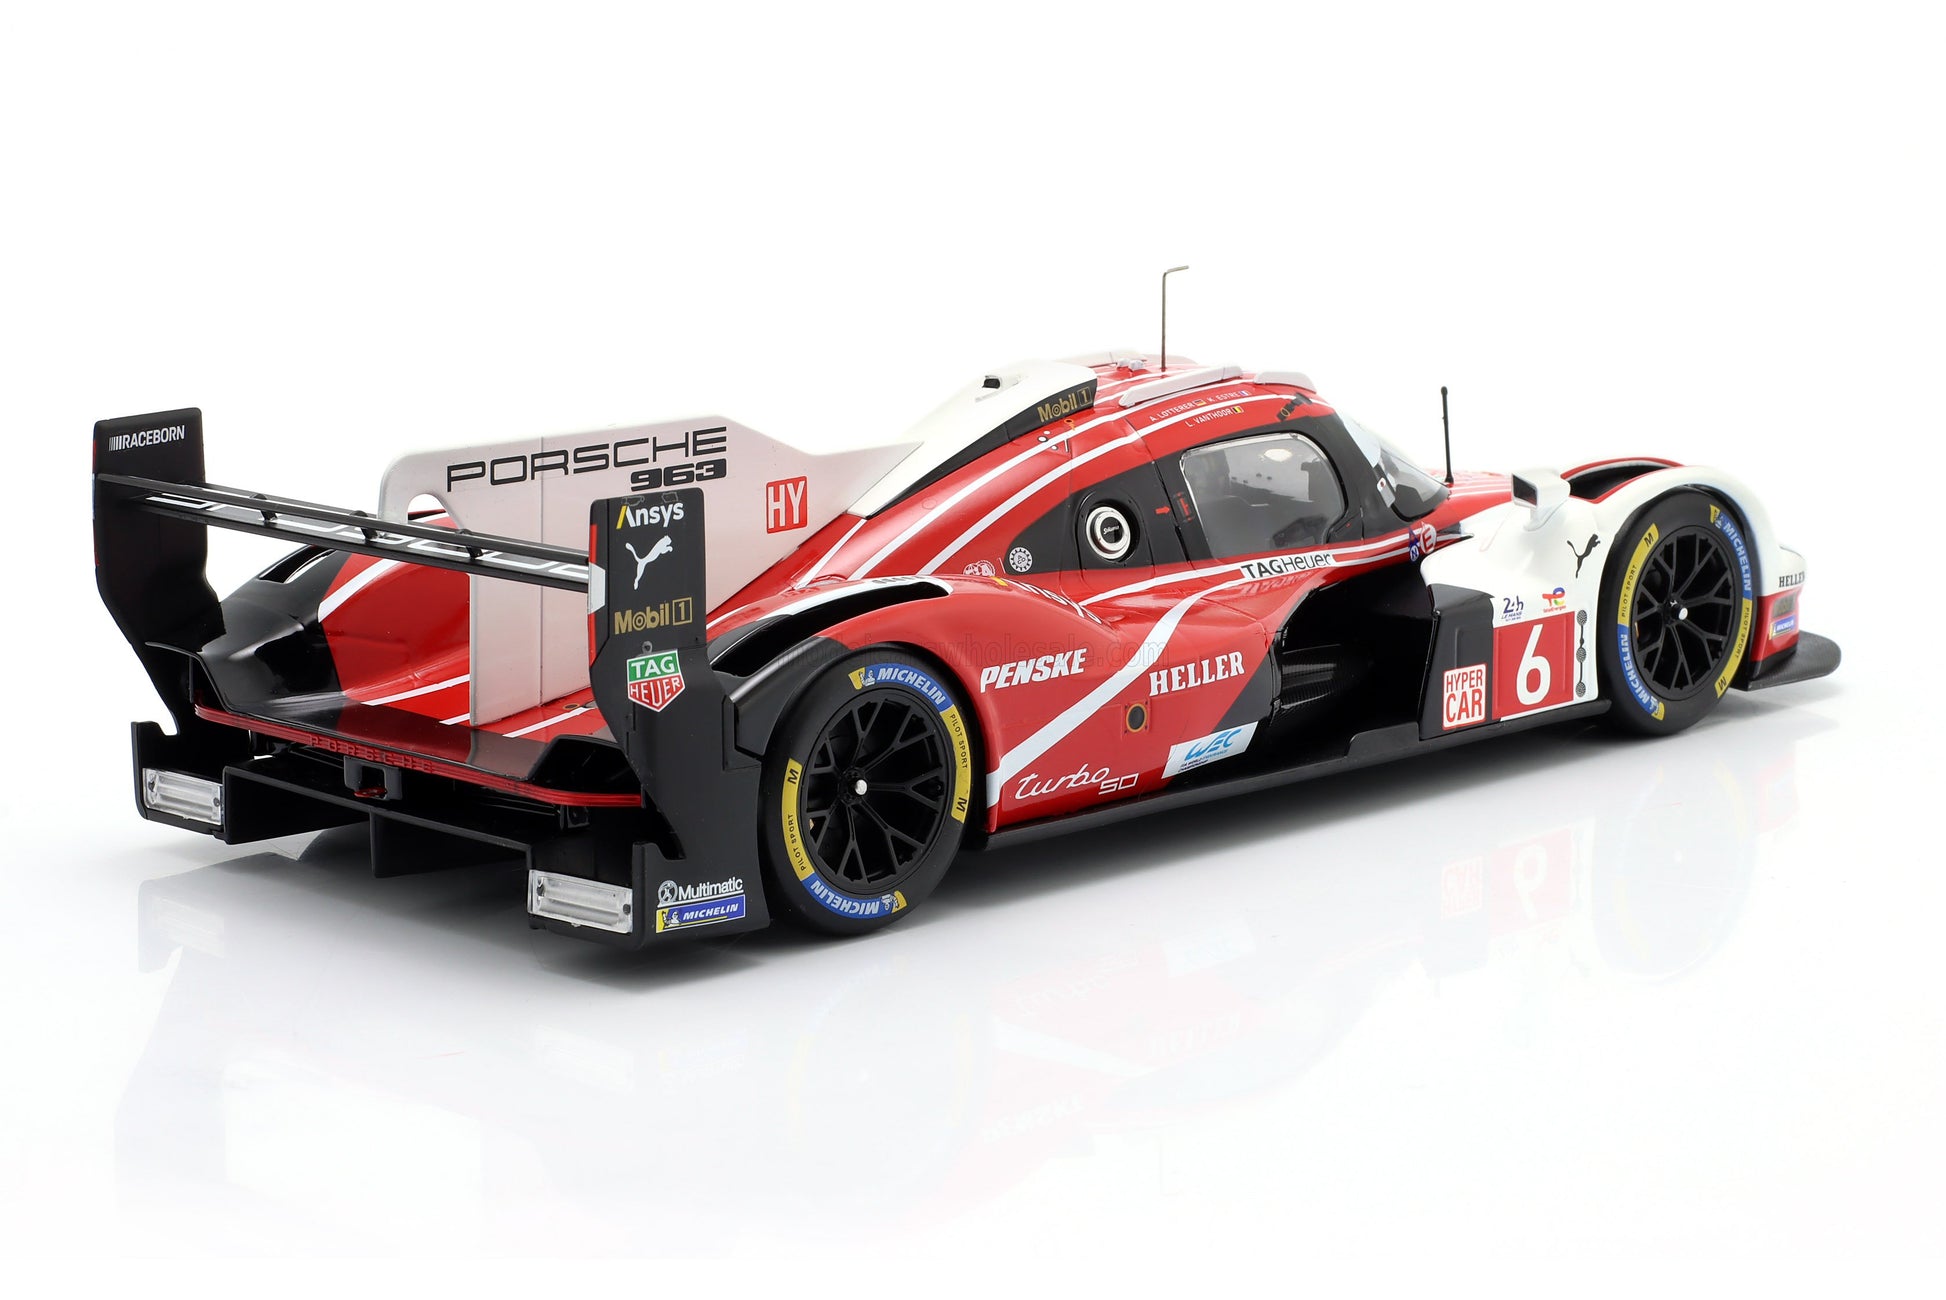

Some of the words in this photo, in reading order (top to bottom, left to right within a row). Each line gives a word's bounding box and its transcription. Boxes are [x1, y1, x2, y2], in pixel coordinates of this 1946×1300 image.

[1037, 393, 1078, 422] Mobil
[1158, 402, 1194, 419] LOTTERER
[1194, 408, 1233, 425] VANTHOOR
[122, 425, 186, 449] RACEBORN
[447, 426, 727, 492] PORSCHE
[630, 458, 727, 491] 963
[616, 502, 684, 529] Ansys
[768, 479, 806, 530] HY
[1644, 532, 1655, 548] M
[1723, 522, 1752, 592] MICHELIN
[1621, 594, 1629, 618] PILOT
[1627, 564, 1637, 592] SPORT
[614, 602, 670, 635] Mobil
[630, 656, 676, 679] TAG
[980, 648, 1087, 692] PENSKE
[1149, 651, 1246, 697] HELLER
[1446, 669, 1483, 693] HYPER
[1516, 624, 1551, 706] 6
[1621, 633, 1652, 704] MICHELIN
[629, 676, 682, 710] HEUER
[877, 667, 947, 706] MICHELIN
[1446, 688, 1483, 723] CAR
[950, 713, 963, 737] PILOT
[958, 740, 968, 769] SPORT
[1184, 729, 1242, 761] WEC
[787, 768, 799, 785] M
[1015, 763, 1110, 800] turbo
[1098, 773, 1139, 795] 50
[956, 797, 968, 812] M
[788, 814, 797, 844] SPORT
[792, 846, 807, 871] PILOT
[678, 876, 743, 900] Multimatic
[810, 880, 880, 915] MICHELIN
[682, 903, 739, 920] MICHELIN
